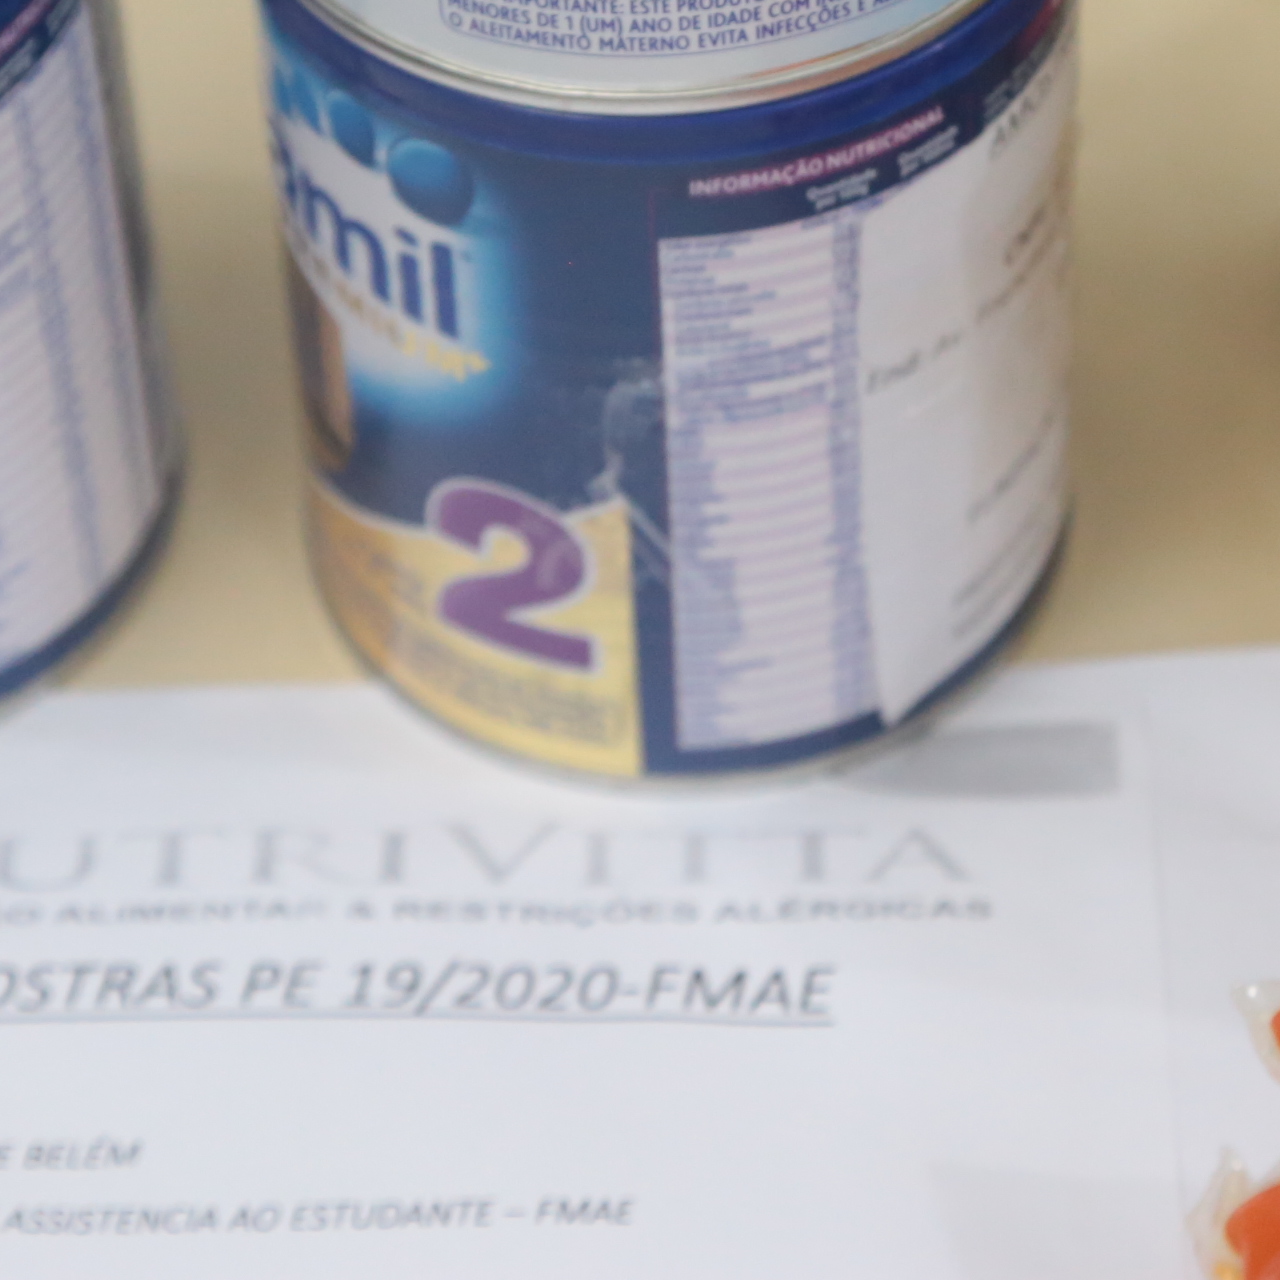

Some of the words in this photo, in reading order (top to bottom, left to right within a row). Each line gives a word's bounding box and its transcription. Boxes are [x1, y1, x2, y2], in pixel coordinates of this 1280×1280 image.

[448, 11, 463, 28] O
[468, 17, 592, 51] ALEITAMENTO
[598, 34, 690, 53] MATERNO
[697, 27, 749, 49] EVITA
[754, 0, 852, 41] INFECÇÕES
[536, 11, 560, 30] DE
[566, 14, 574, 31] 1
[579, 14, 624, 37] (UM)
[629, 17, 673, 34] ANO
[678, 14, 702, 32] DE
[707, 5, 762, 29] IDADE
[688, 156, 822, 198] INFORMAÇÃO
[823, 105, 947, 172] NUTRICIONAL
[431, 484, 594, 669] 2
[238, 957, 324, 1011] PE
[348, 957, 839, 1017] 19/2020-FMAE
[20, 1132, 143, 1171] BELÉM
[0, 1201, 217, 1236] ASSISTENCIA
[225, 1201, 286, 1234] AO
[288, 1197, 496, 1232] ESTUDANTE
[533, 1196, 635, 1226] FMAE
